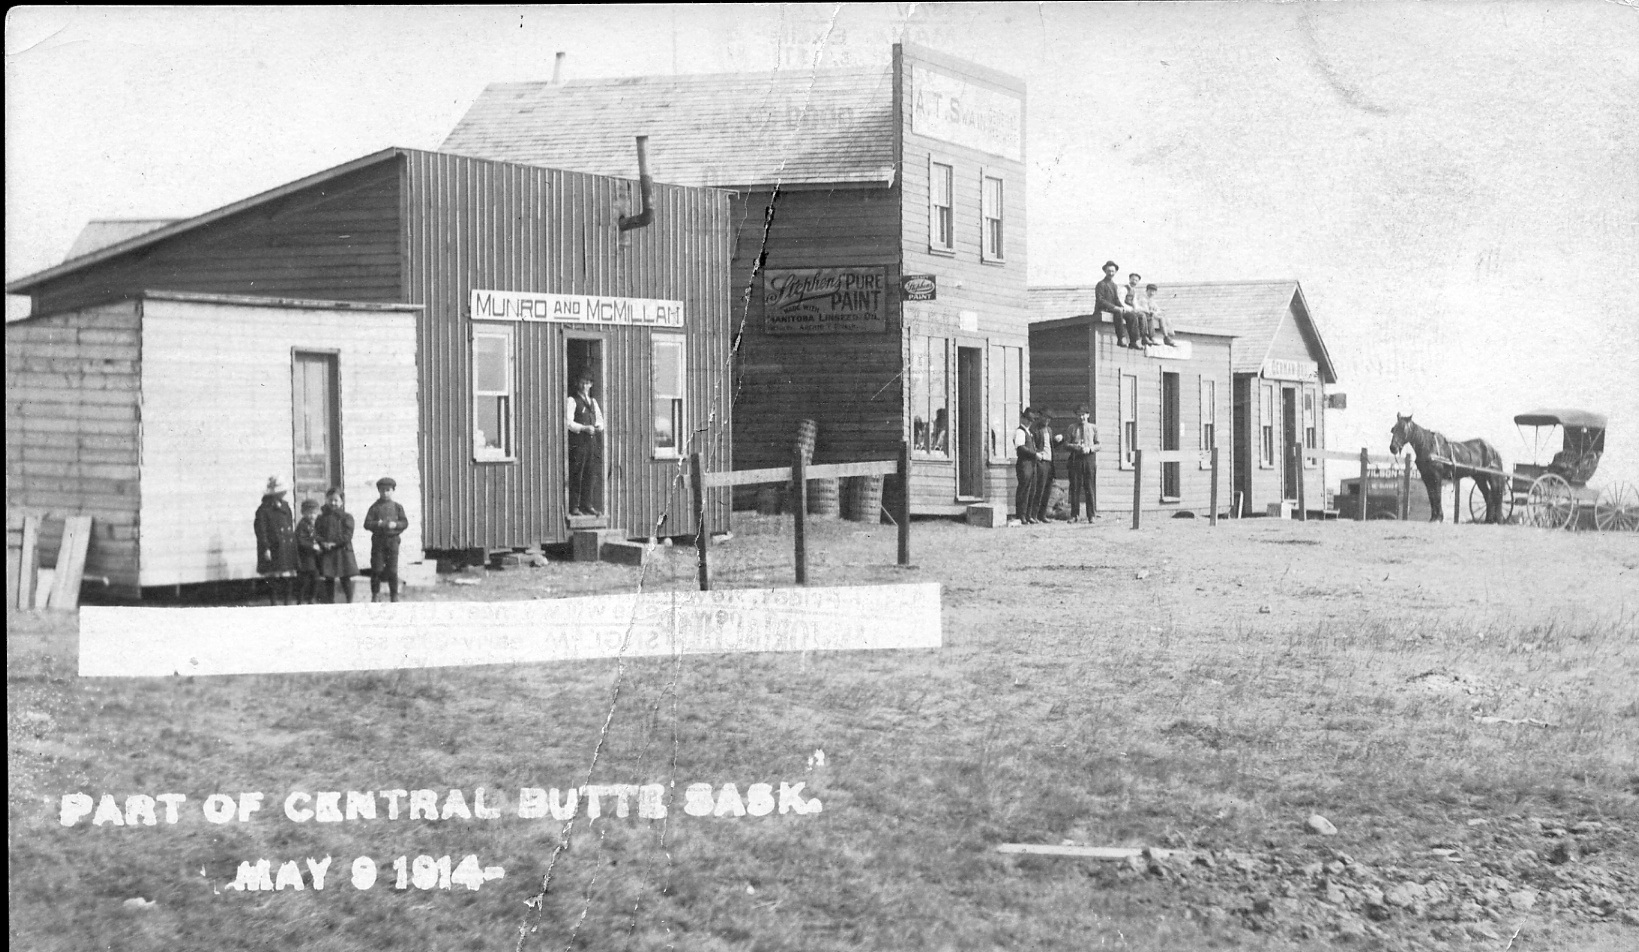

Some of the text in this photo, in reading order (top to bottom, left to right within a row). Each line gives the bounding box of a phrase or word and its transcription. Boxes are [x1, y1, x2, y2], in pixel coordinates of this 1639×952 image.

[846, 272, 884, 290] PURE
[475, 293, 548, 319] MUNRO
[553, 300, 581, 316] AND
[830, 290, 882, 312] PAINT
